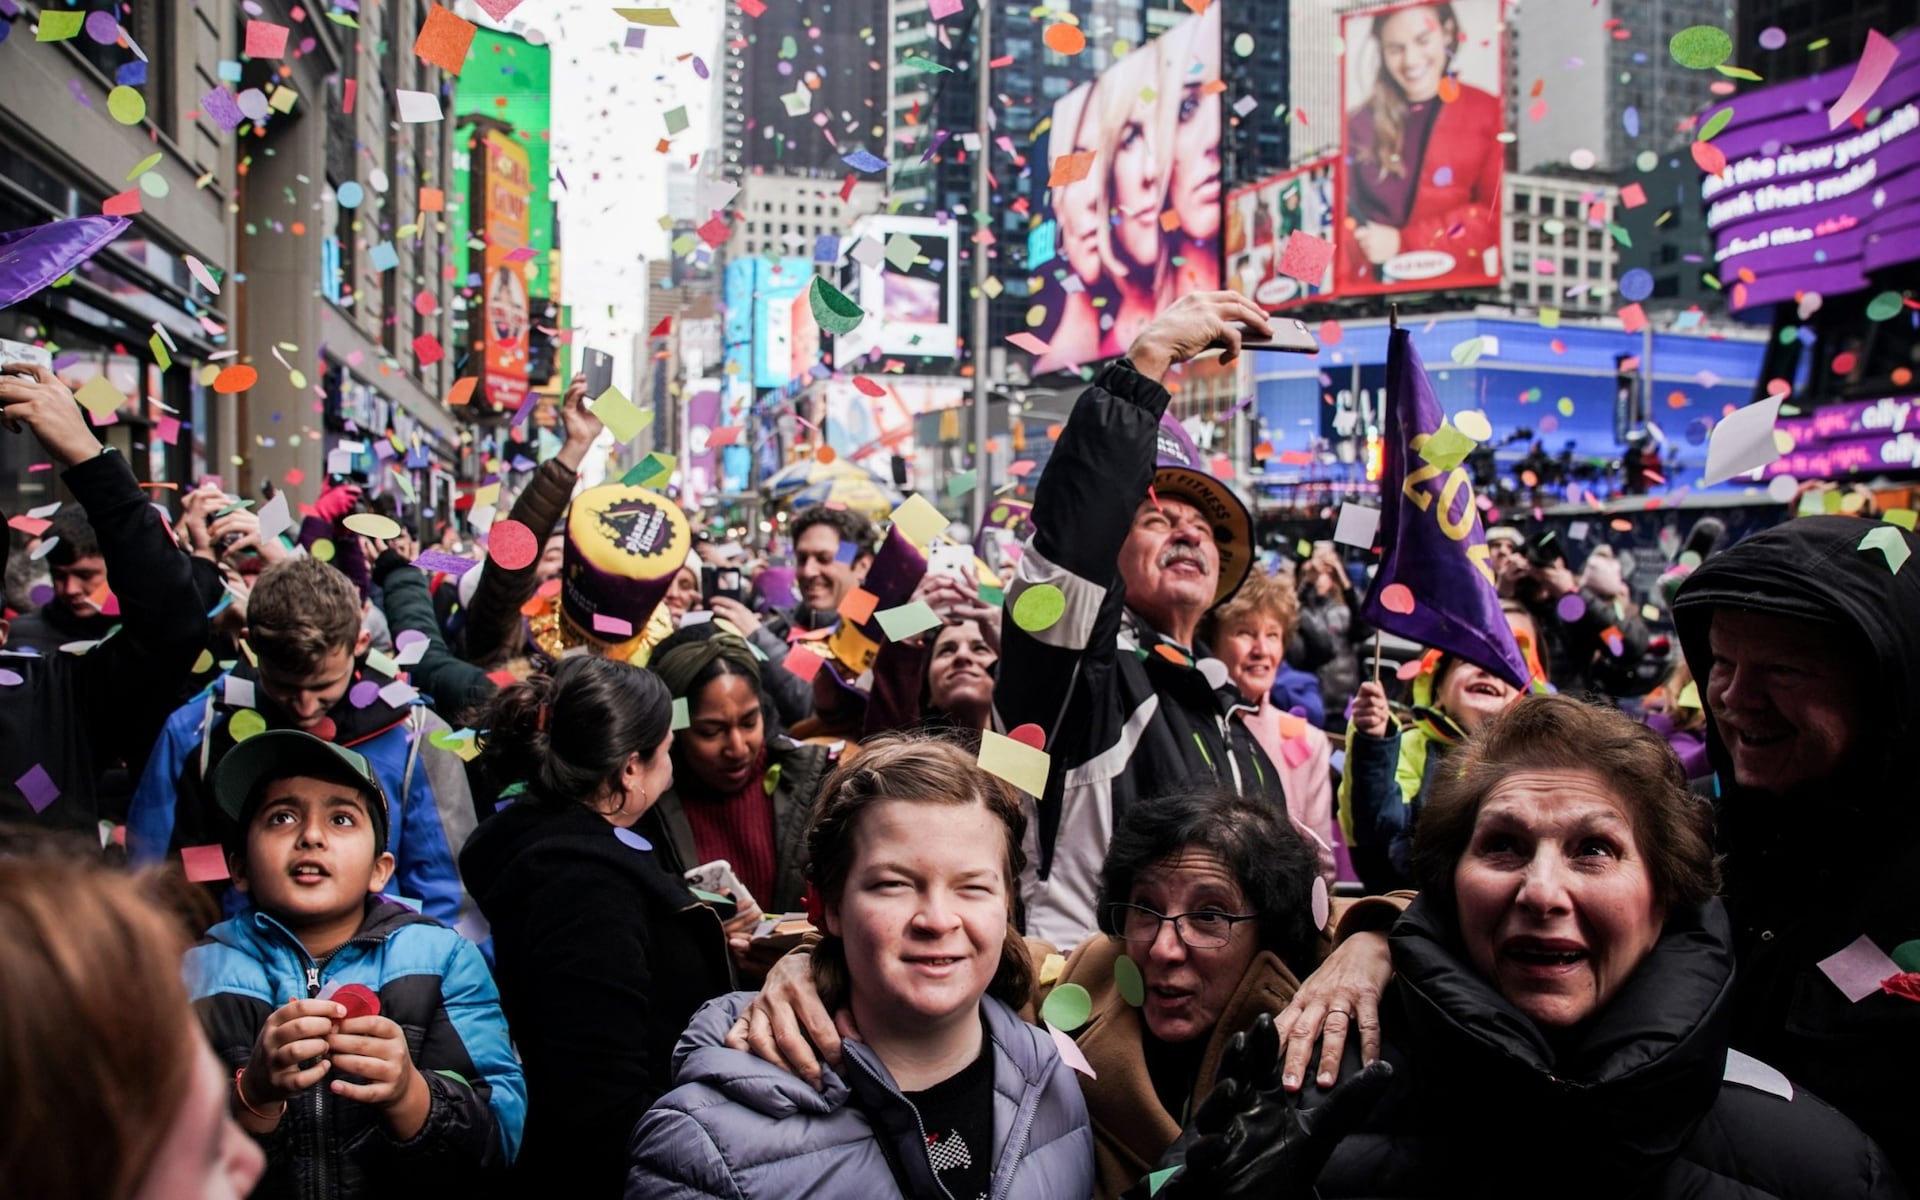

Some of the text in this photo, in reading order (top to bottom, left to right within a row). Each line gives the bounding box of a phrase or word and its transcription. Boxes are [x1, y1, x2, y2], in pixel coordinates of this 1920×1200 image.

[1735, 157, 1774, 184] the
[1777, 145, 1834, 175] new
[1834, 127, 1880, 169] year
[1755, 180, 1815, 212] that
[1861, 398, 1911, 433] ally
[1177, 474, 1231, 521] FITNESS
